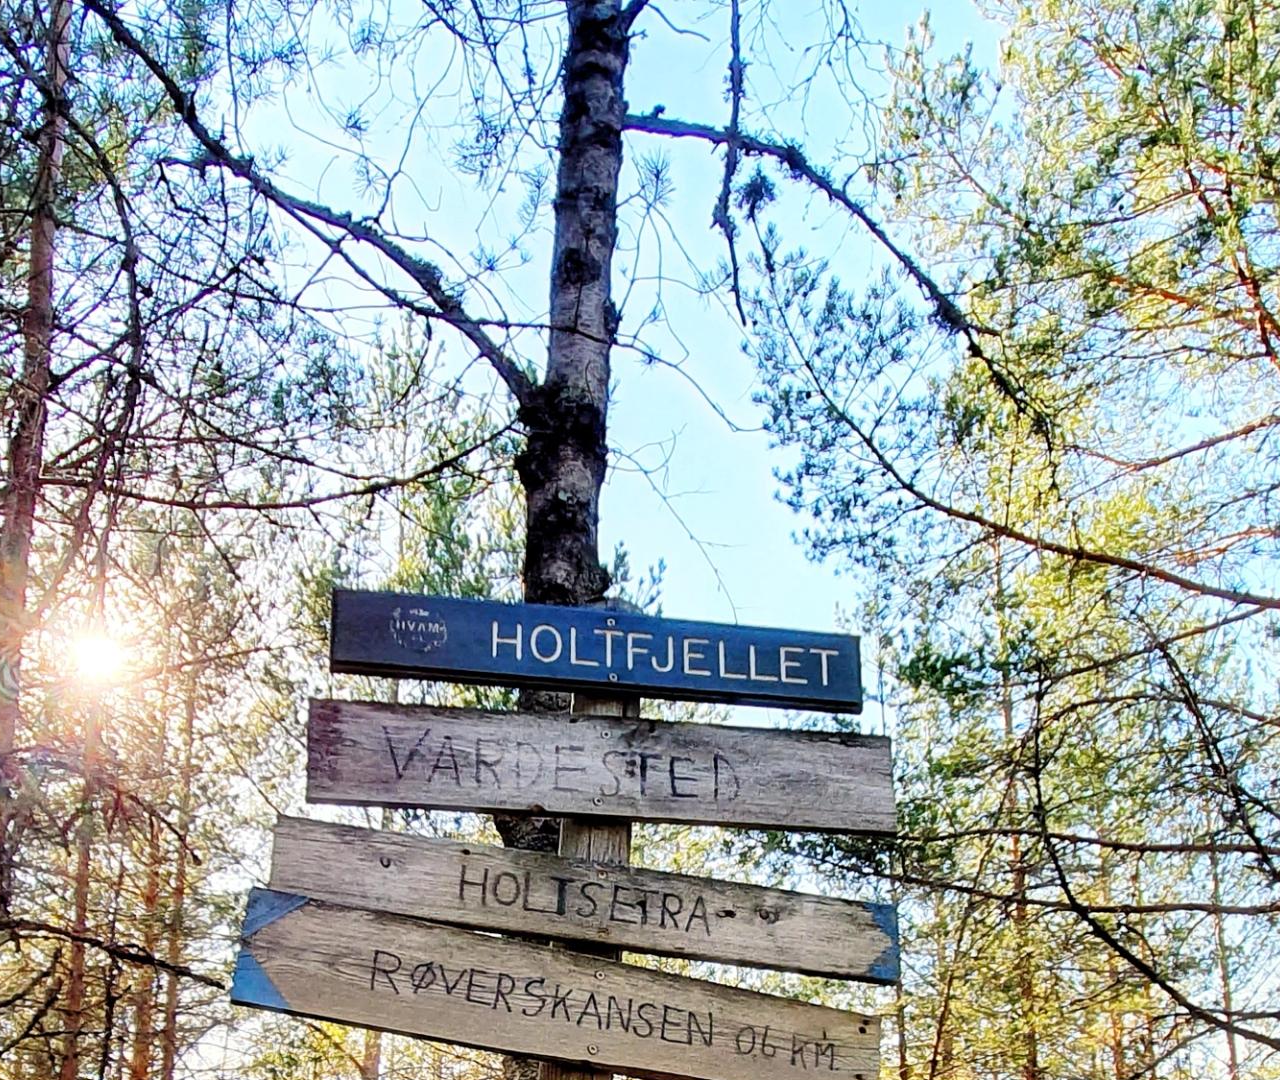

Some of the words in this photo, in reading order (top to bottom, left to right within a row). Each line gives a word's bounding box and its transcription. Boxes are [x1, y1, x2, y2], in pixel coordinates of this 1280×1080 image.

[491, 621, 839, 686] HOLTFJELLET
[382, 726, 740, 801] VARDESTED
[459, 865, 711, 936] HOLTSETRA
[369, 950, 714, 1047] RØVERSKANSEN
